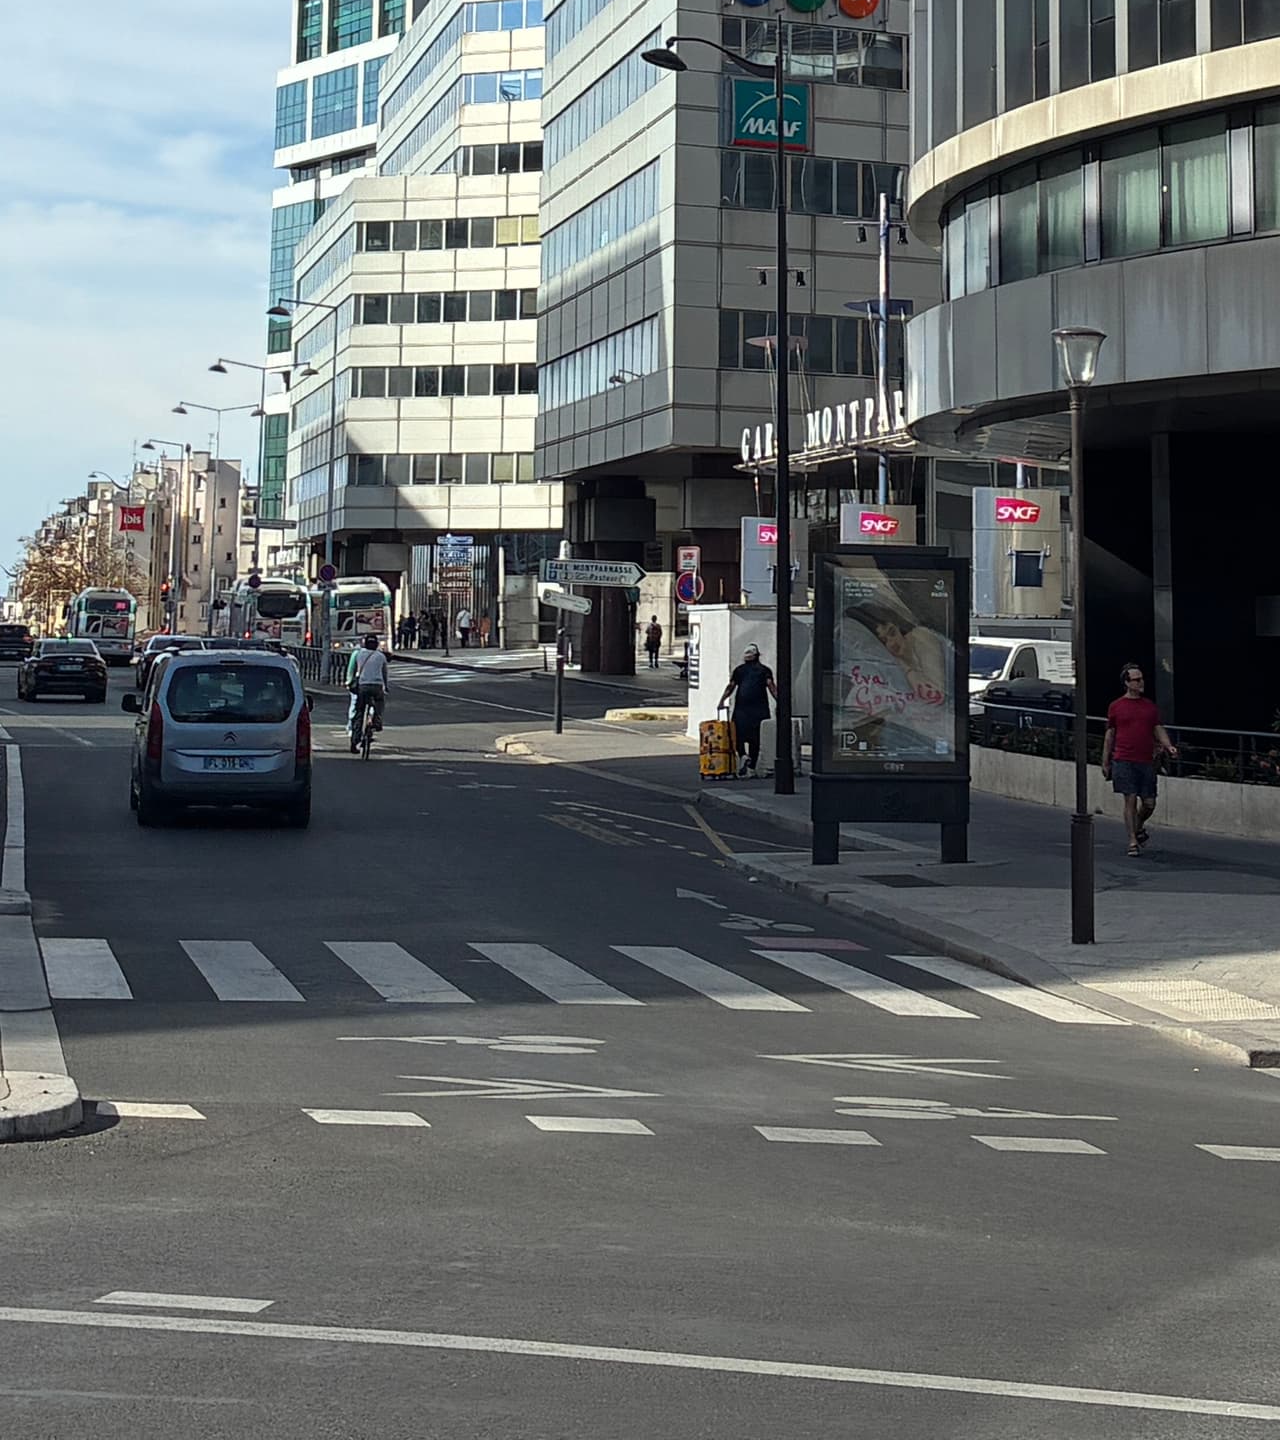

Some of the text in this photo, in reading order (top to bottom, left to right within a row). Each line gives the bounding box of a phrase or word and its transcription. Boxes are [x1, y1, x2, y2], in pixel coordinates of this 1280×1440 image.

[741, 389, 907, 463] GAR MONTPAR
[123, 512, 142, 524] ibis
[997, 506, 1039, 520] SNCF
[860, 519, 898, 532] SNCF
[851, 665, 888, 686] Eva
